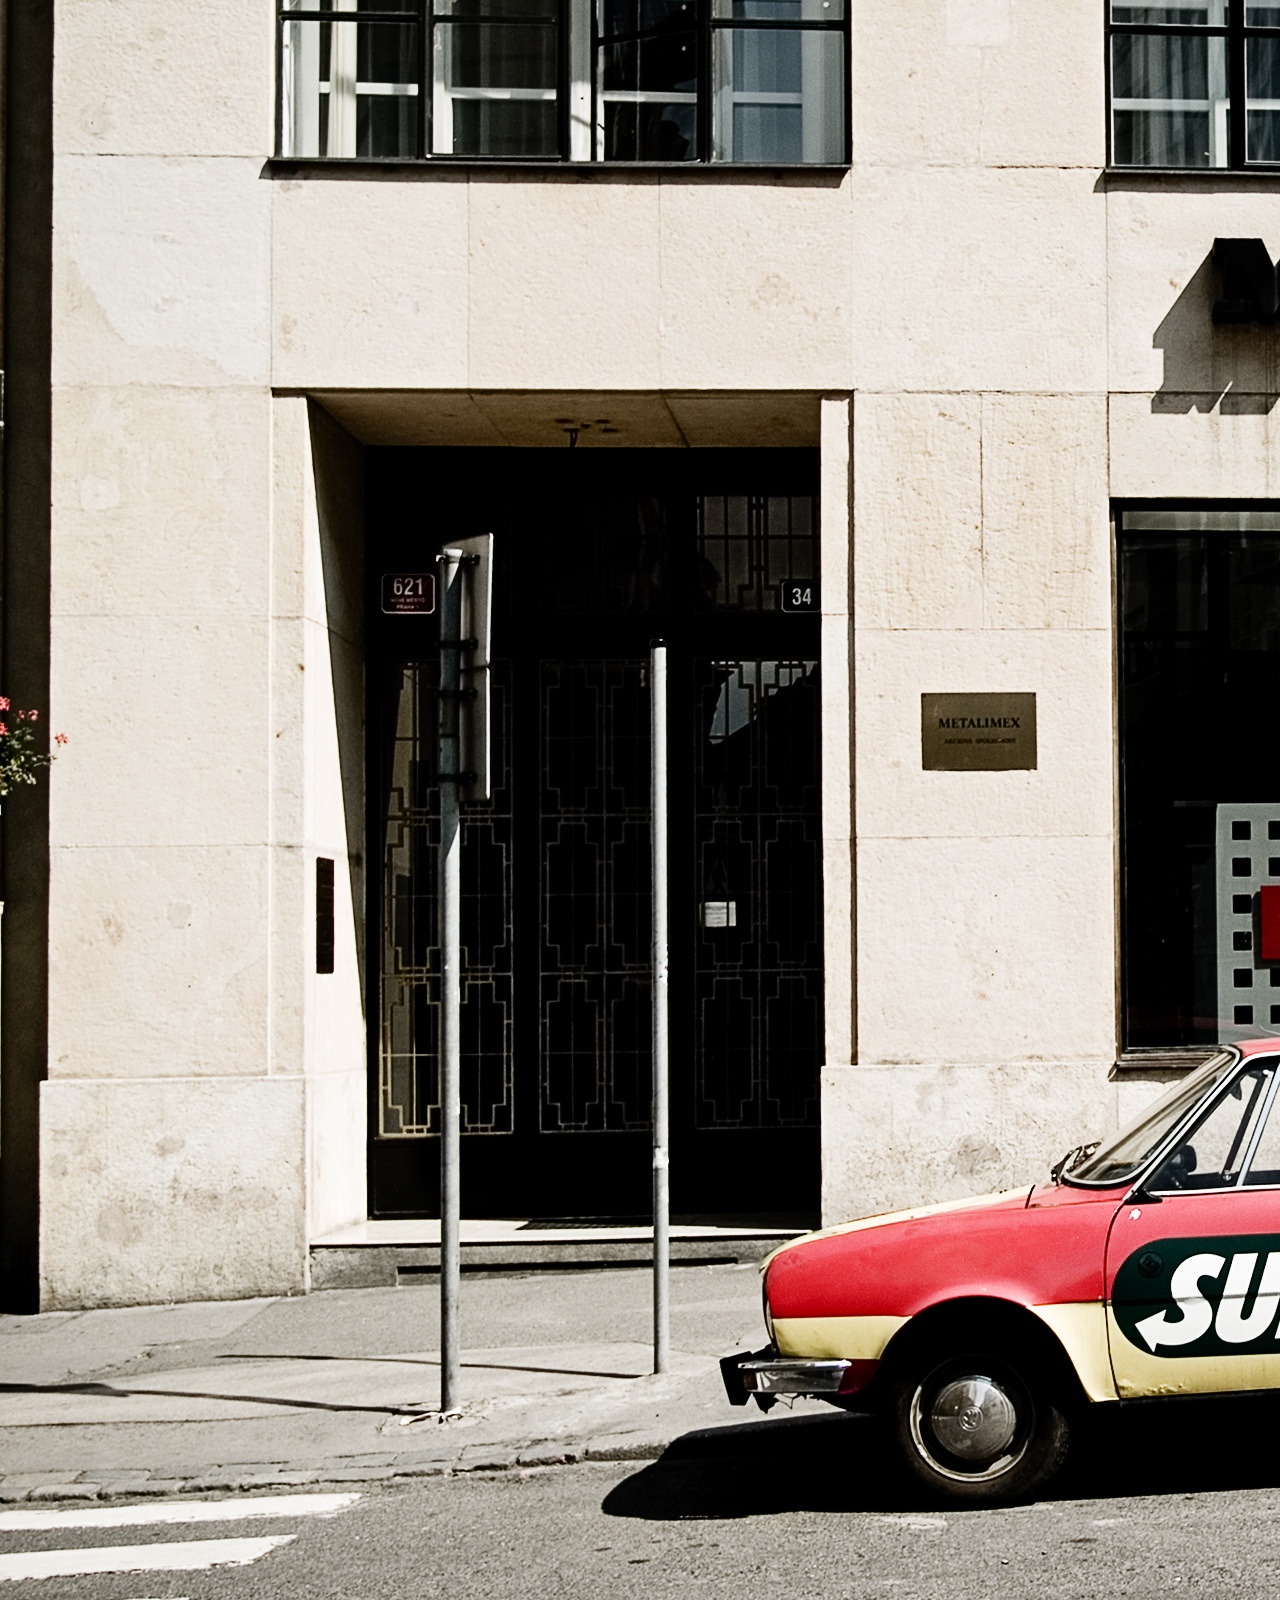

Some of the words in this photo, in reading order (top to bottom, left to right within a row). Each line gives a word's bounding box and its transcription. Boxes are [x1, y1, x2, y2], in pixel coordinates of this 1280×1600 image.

[393, 578, 422, 595] 621
[792, 587, 812, 605] 34
[938, 717, 1020, 728] METALIMEX
